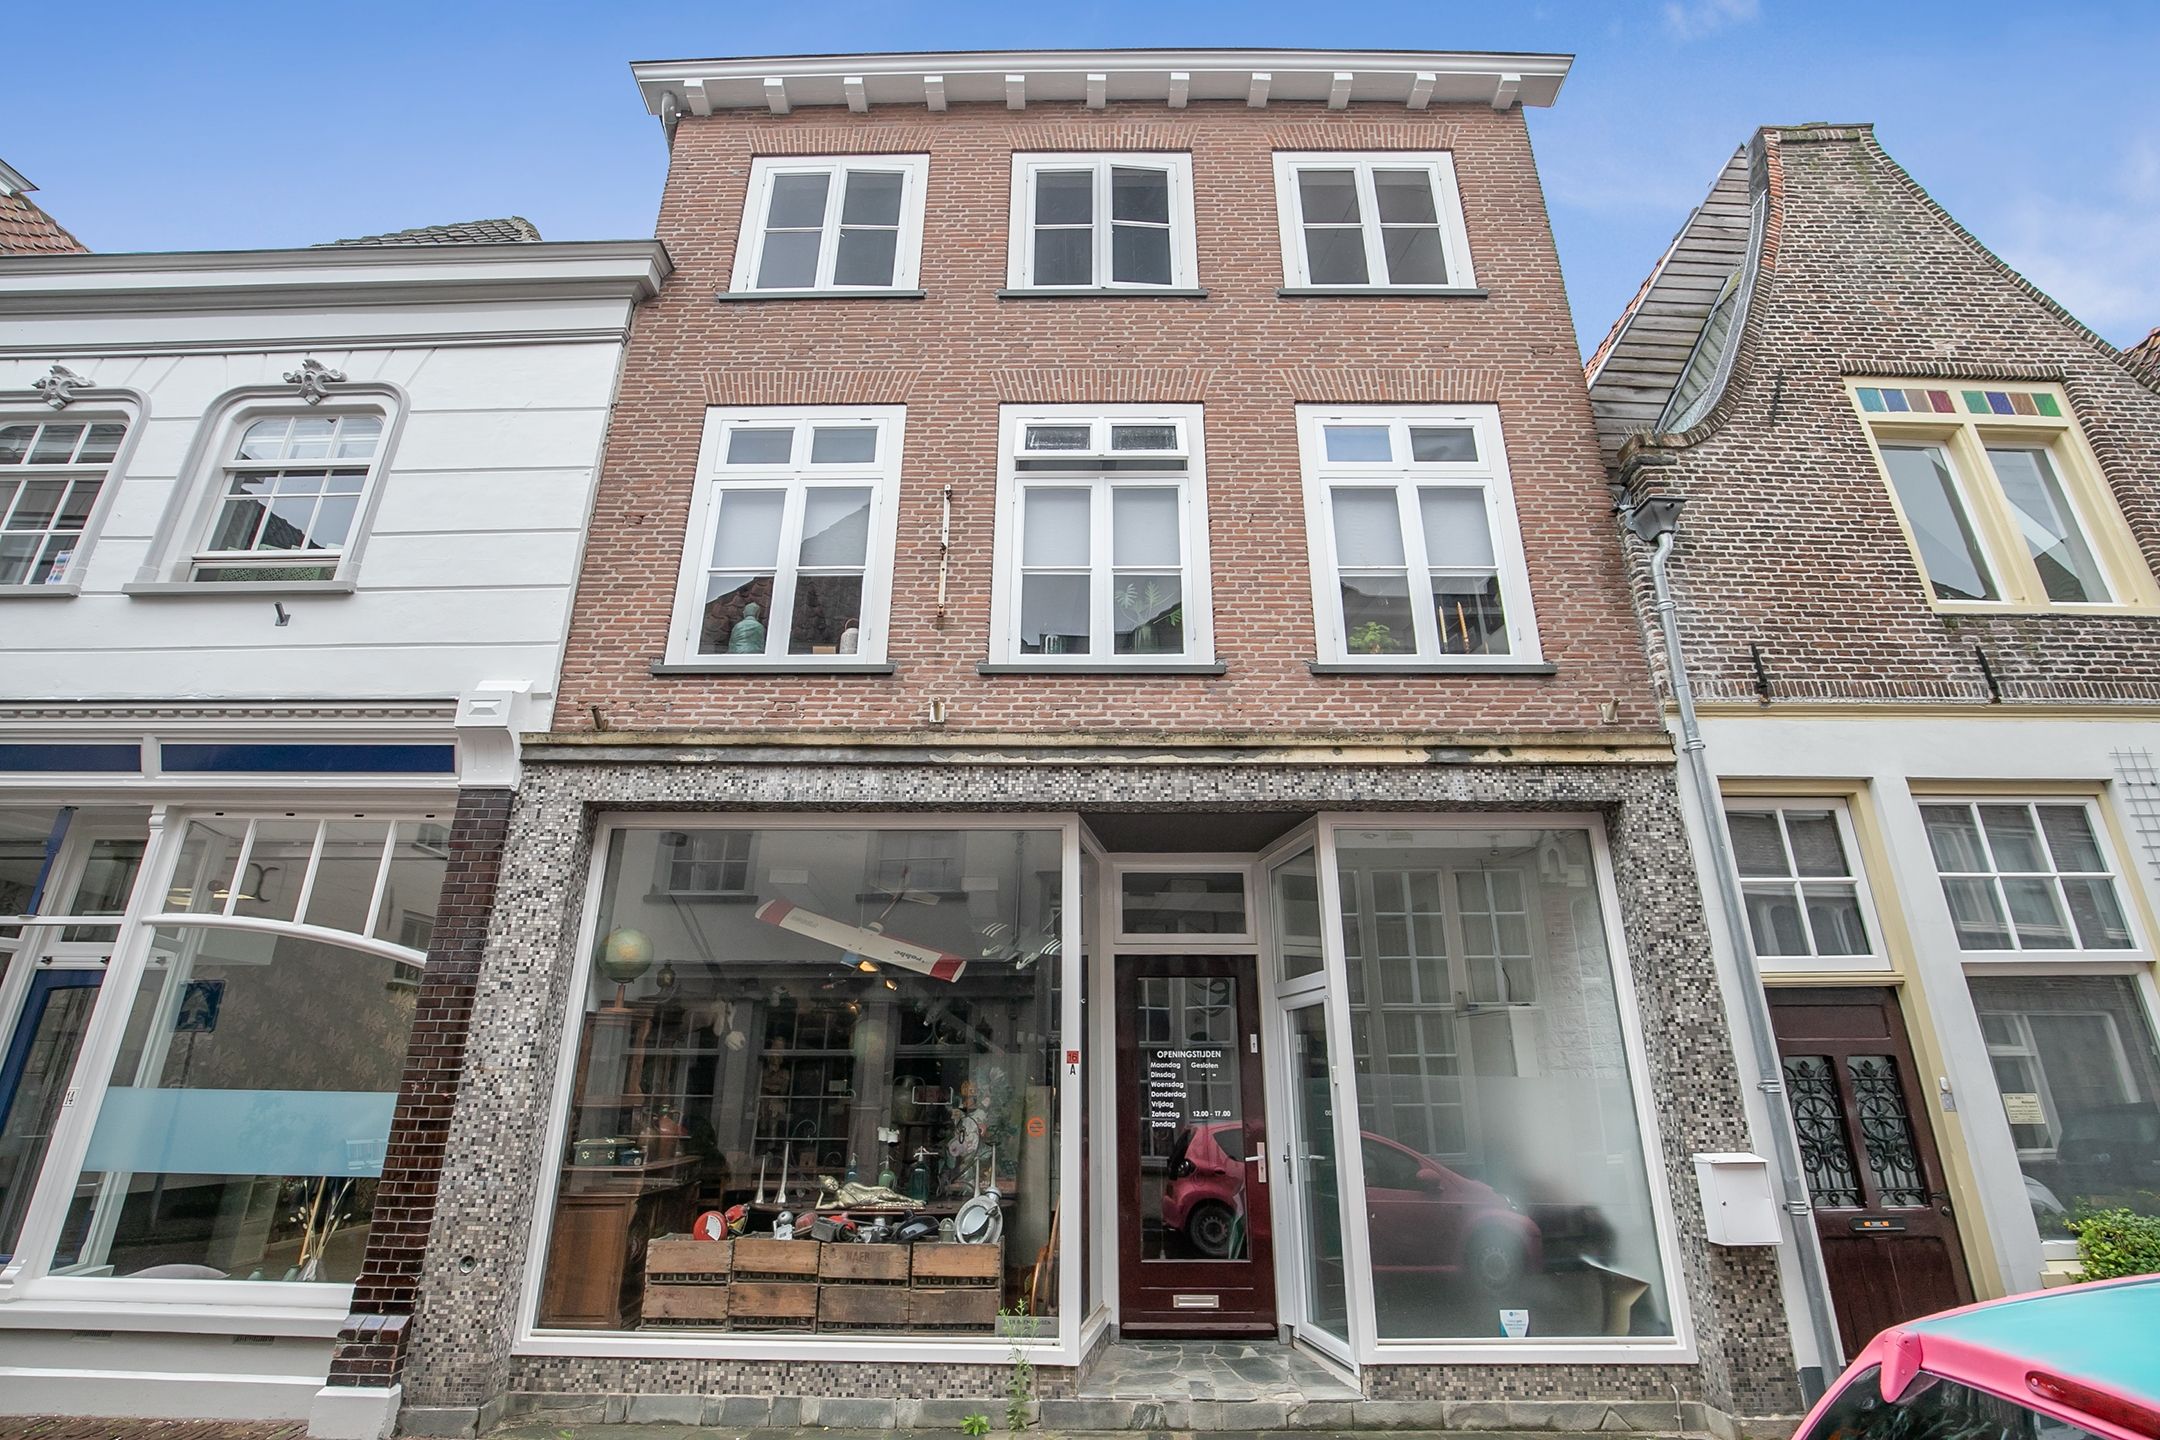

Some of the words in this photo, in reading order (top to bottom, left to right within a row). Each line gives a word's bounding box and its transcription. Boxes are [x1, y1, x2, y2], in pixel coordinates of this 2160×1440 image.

[1068, 1053, 1078, 1062] 16
[1150, 1061, 1181, 1069] Maandag
[1190, 1061, 1219, 1069] Gesloten
[1070, 1064, 1076, 1075] A
[1150, 1071, 1176, 1079] Dinsdag
